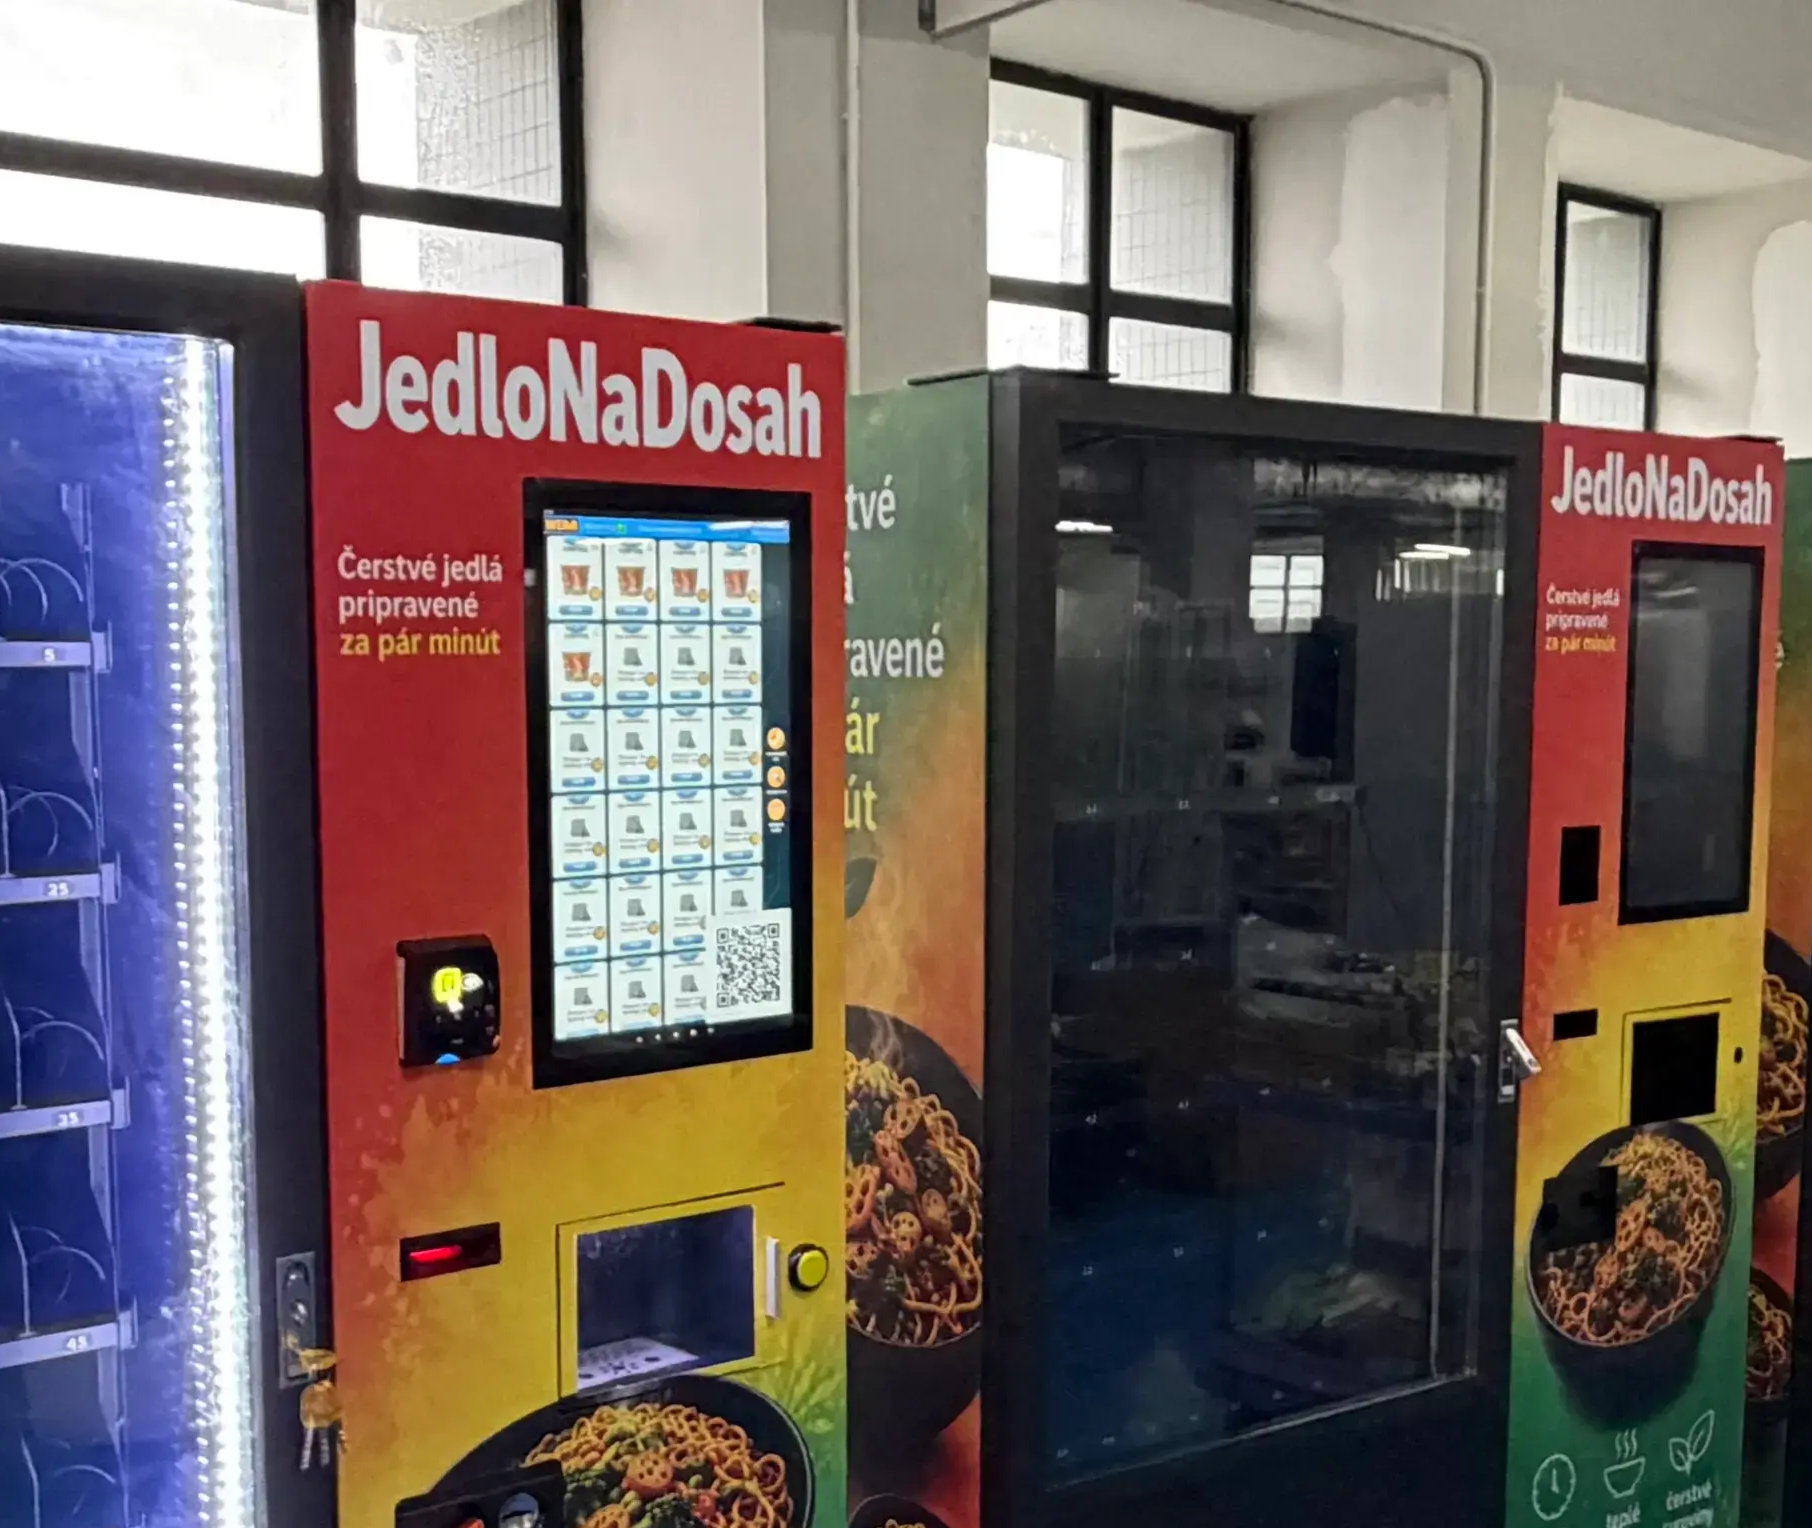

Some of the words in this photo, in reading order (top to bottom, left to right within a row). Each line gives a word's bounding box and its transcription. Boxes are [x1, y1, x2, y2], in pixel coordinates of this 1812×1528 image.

[333, 319, 823, 459] JedloNaDosah
[1551, 445, 1773, 525] JedloNaDosah
[337, 544, 437, 581] Čerstvé
[441, 553, 503, 588] jedlá
[338, 588, 479, 626] pripravené
[44, 648, 55, 663] 5
[339, 632, 370, 656] za
[378, 626, 423, 662] pár
[429, 626, 502, 656] minút
[48, 882, 69, 897] 25
